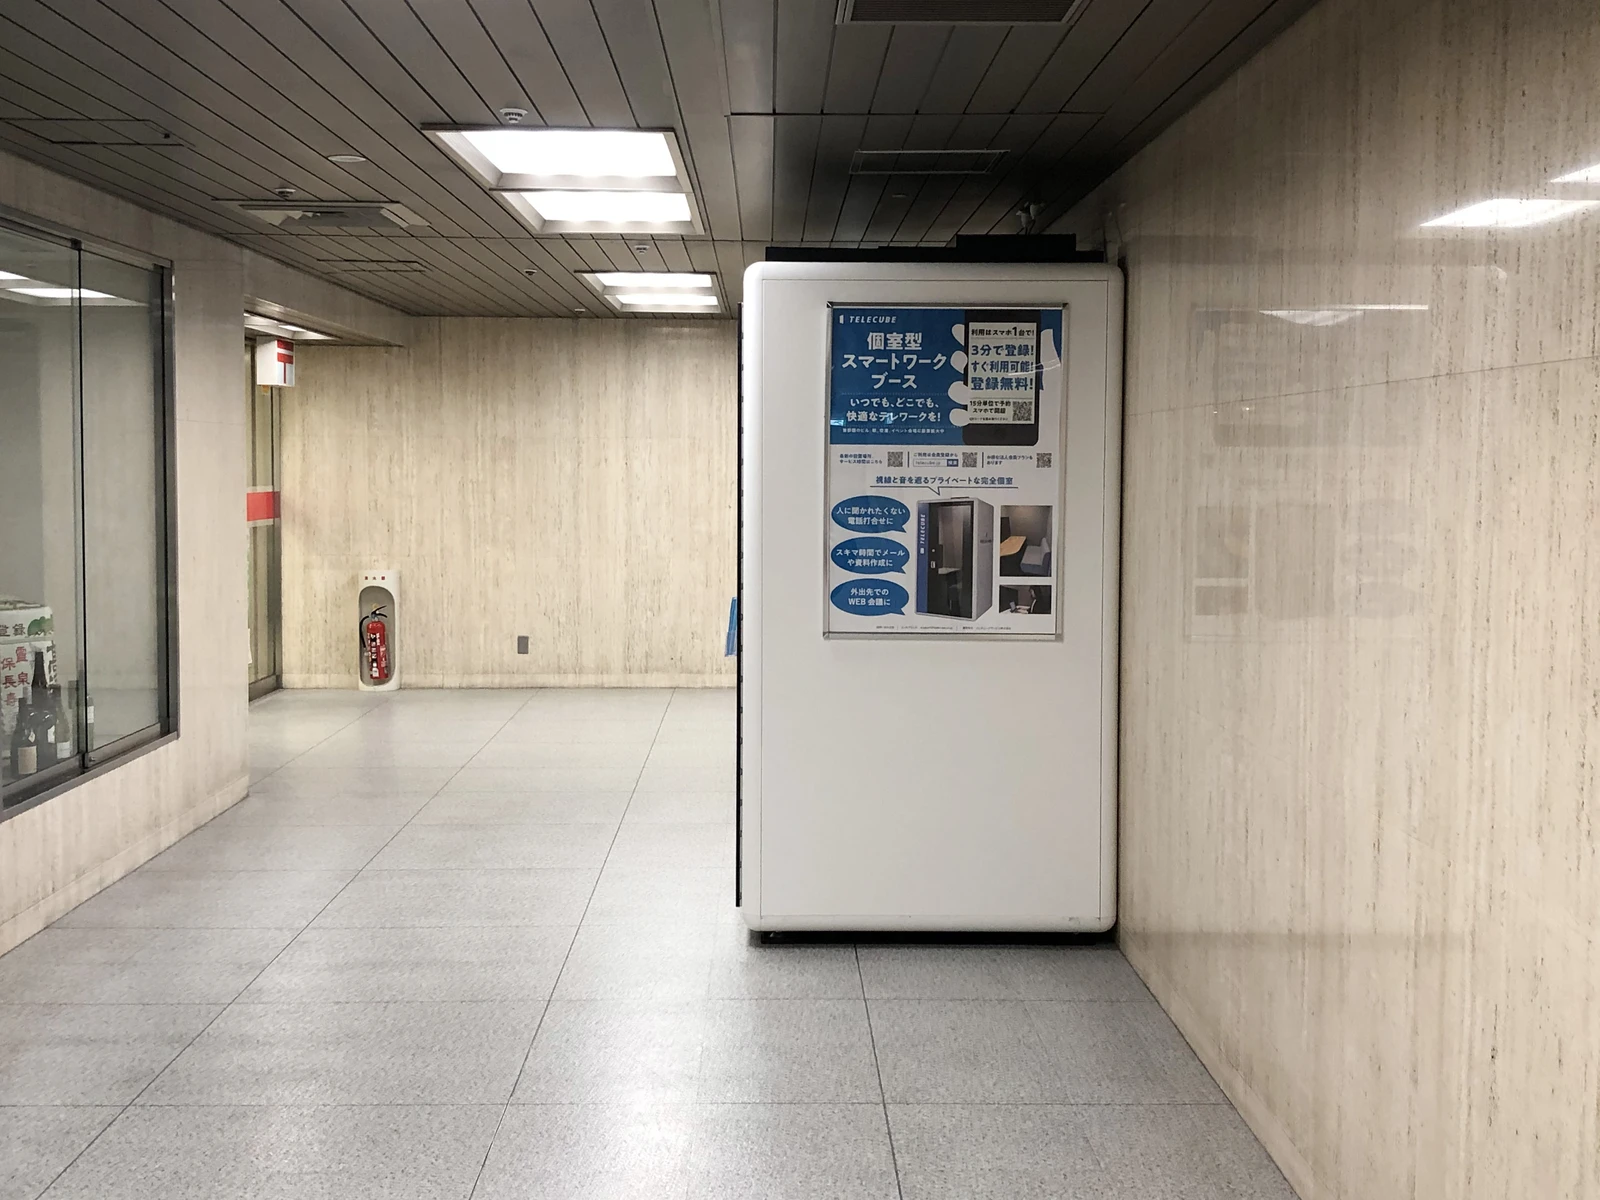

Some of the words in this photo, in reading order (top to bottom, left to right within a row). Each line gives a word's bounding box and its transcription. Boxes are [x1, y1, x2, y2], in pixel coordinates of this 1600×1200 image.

[849, 316, 897, 324] TELECUBE
[867, 332, 923, 350] 個室型
[841, 354, 948, 371] スマートワーク
[871, 372, 918, 389] ブース
[850, 397, 940, 408] いつでも、どこでも、
[875, 476, 1013, 486] 視線と音を遮るプライベートな完全個室
[836, 506, 906, 515] 人に聞かれたくない
[847, 516, 894, 525] 電話打合せに
[836, 548, 905, 557] スキマ時間でメール
[847, 558, 893, 567] や資料作成に
[850, 587, 889, 597] 外出先での
